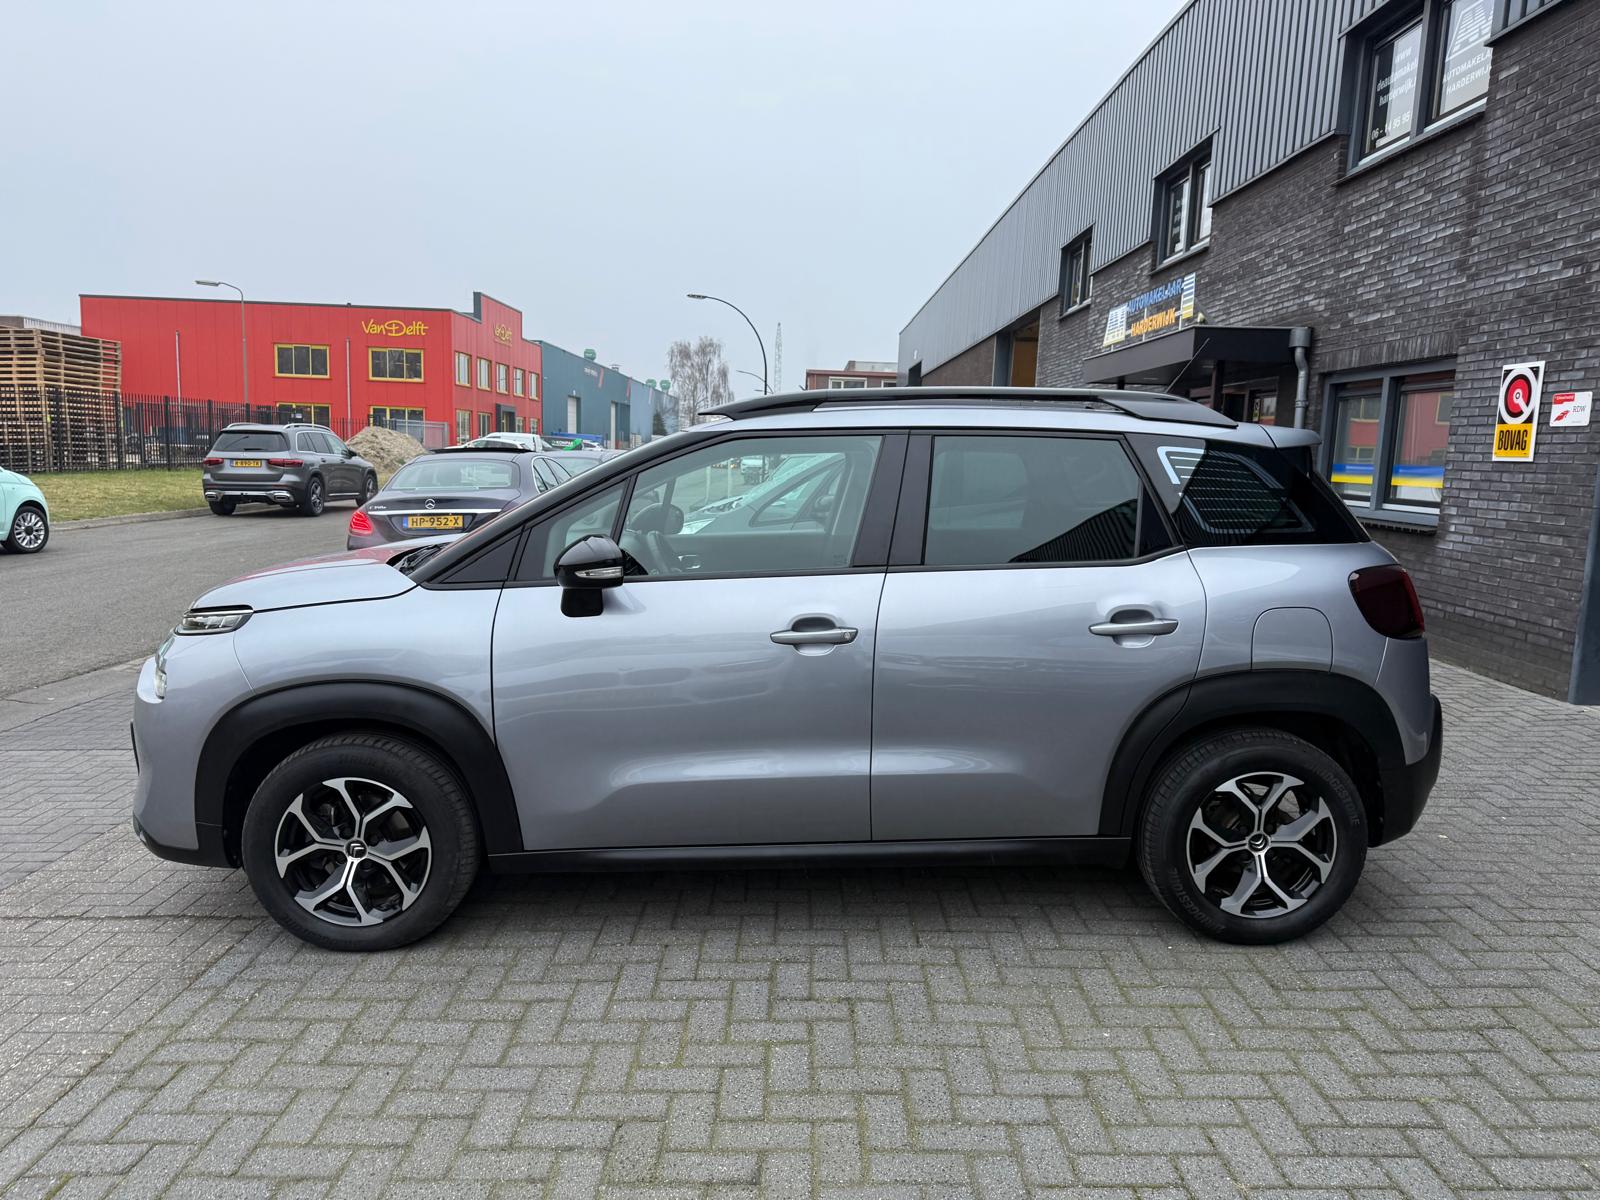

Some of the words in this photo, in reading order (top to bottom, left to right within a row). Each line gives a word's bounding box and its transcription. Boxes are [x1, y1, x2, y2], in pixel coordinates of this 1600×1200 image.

[1447, 64, 1491, 95] HARDERWIJ
[1127, 279, 1182, 315] AUTOMAKELAAR
[1131, 307, 1176, 337] HARDERWIJK
[1497, 429, 1528, 451] BOVAG
[411, 516, 460, 527] HP-952-X
